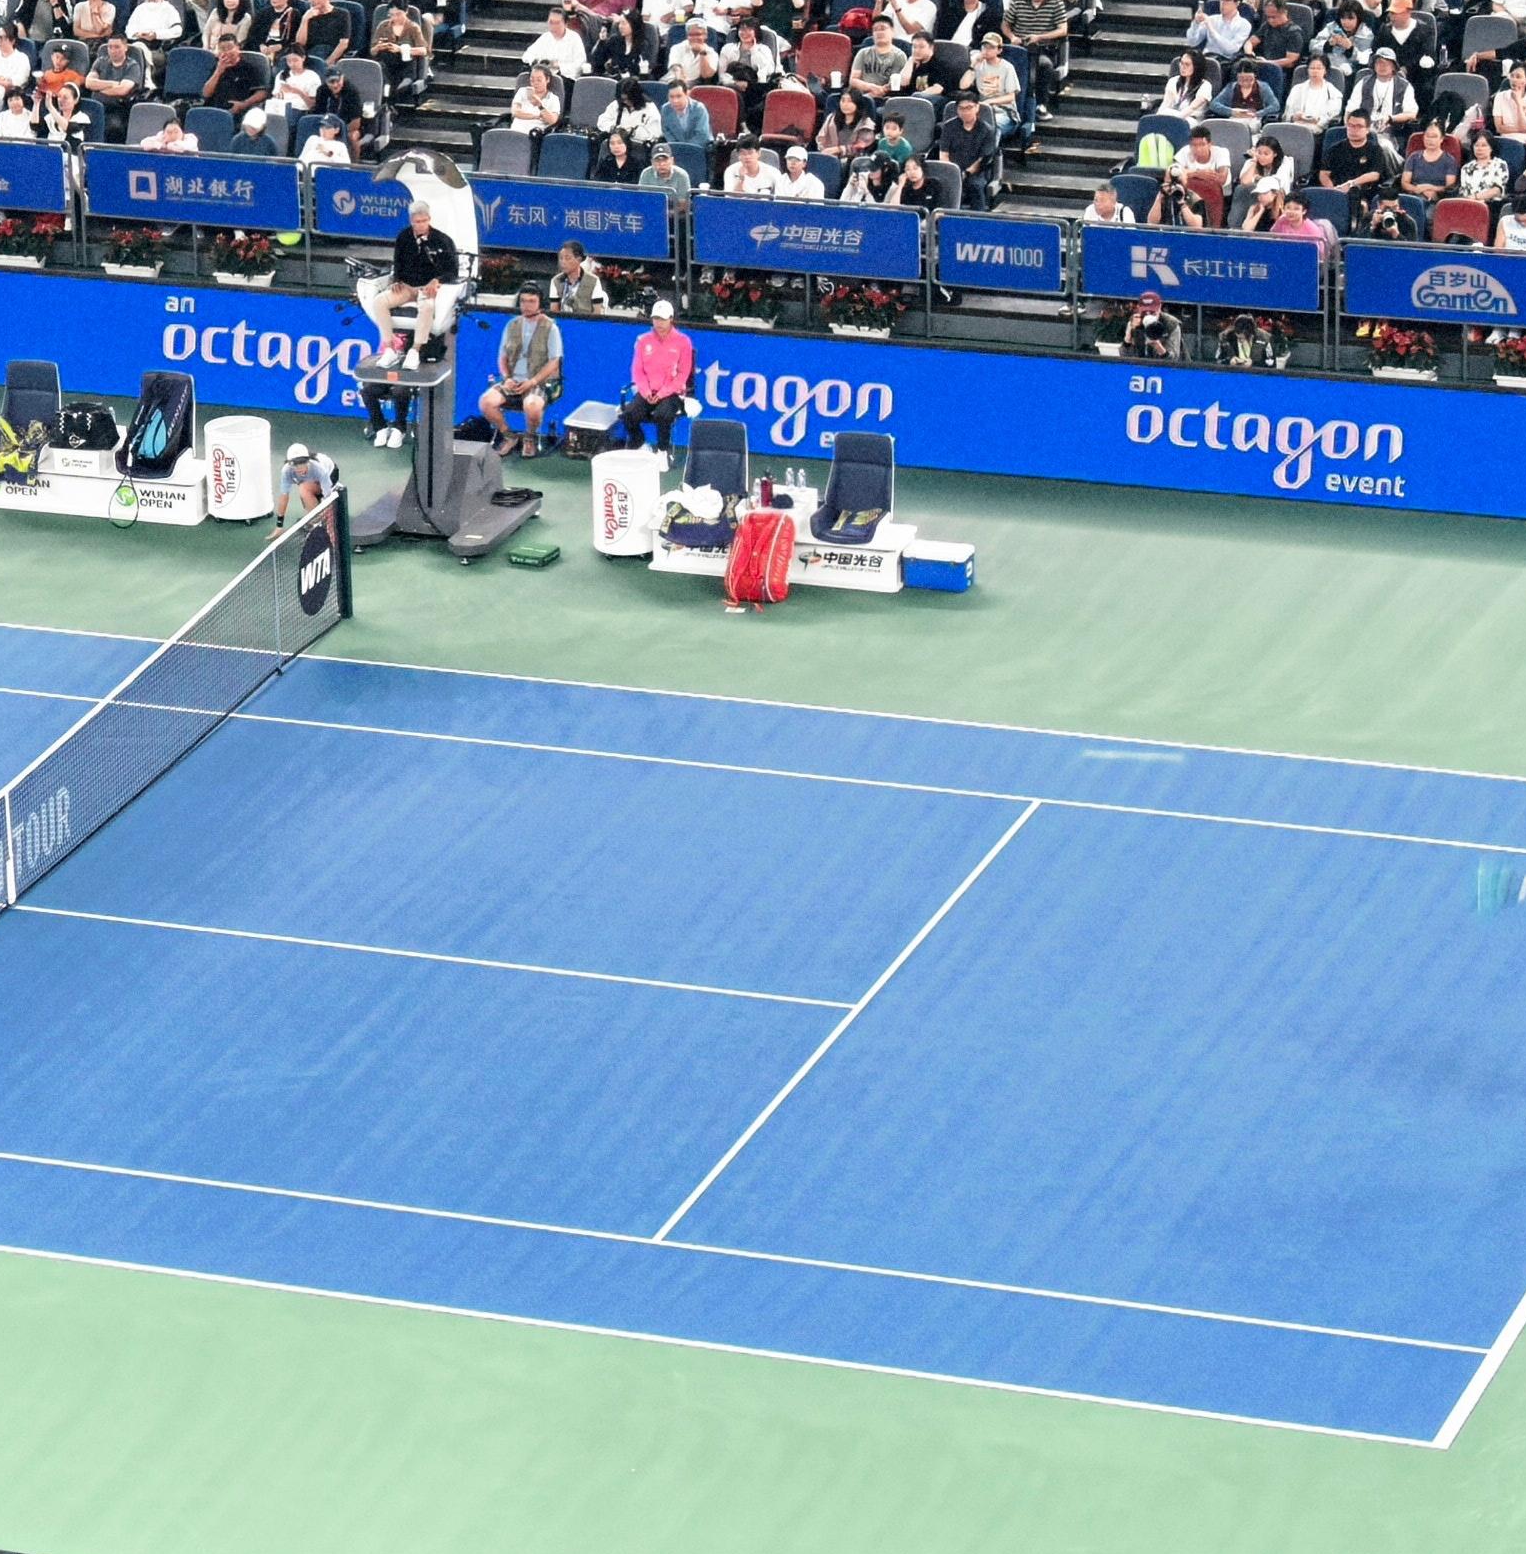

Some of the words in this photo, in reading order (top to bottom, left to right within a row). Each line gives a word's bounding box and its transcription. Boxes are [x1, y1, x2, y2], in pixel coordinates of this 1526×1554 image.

[360, 205, 398, 217] OPEN
[782, 224, 862, 246] 中国光谷
[1429, 271, 1489, 289] 百岁山
[164, 295, 196, 313] an
[1128, 374, 1163, 394] an
[1125, 401, 1403, 489] octagon
[4, 485, 38, 497] OPEN
[1324, 473, 1406, 498] event
[139, 488, 186, 502] WUHAN
[139, 497, 174, 510] OPEN
[823, 552, 884, 569] 中国光谷
[301, 548, 331, 596] WTA
[11, 786, 71, 879] TOUR
